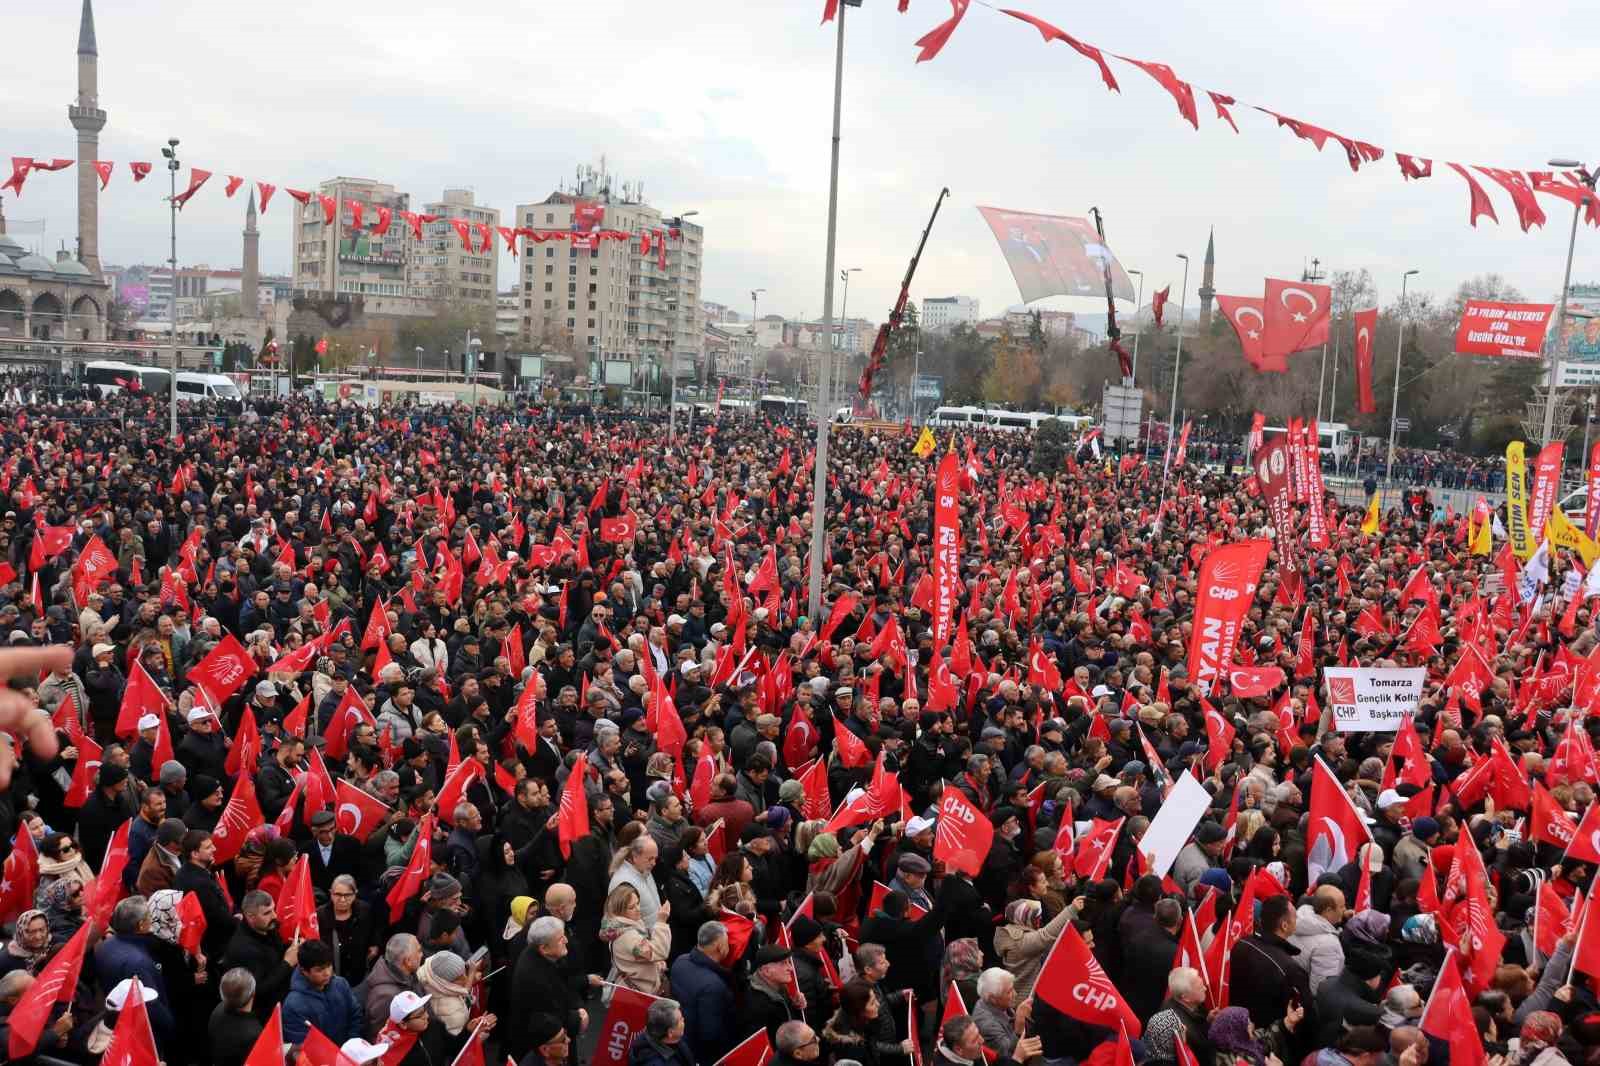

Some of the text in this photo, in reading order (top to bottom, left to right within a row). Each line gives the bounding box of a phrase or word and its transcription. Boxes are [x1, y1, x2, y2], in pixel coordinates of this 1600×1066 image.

[1512, 472, 1520, 499] SEN
[1208, 585, 1239, 601] CHP
[1369, 678, 1412, 687] Tomarza
[1357, 693, 1419, 705] Gençlik Kolla
[1336, 706, 1356, 718] CHP
[943, 796, 976, 824] CHP
[1072, 982, 1117, 1012] CHP
[607, 1020, 629, 1061] CHP
